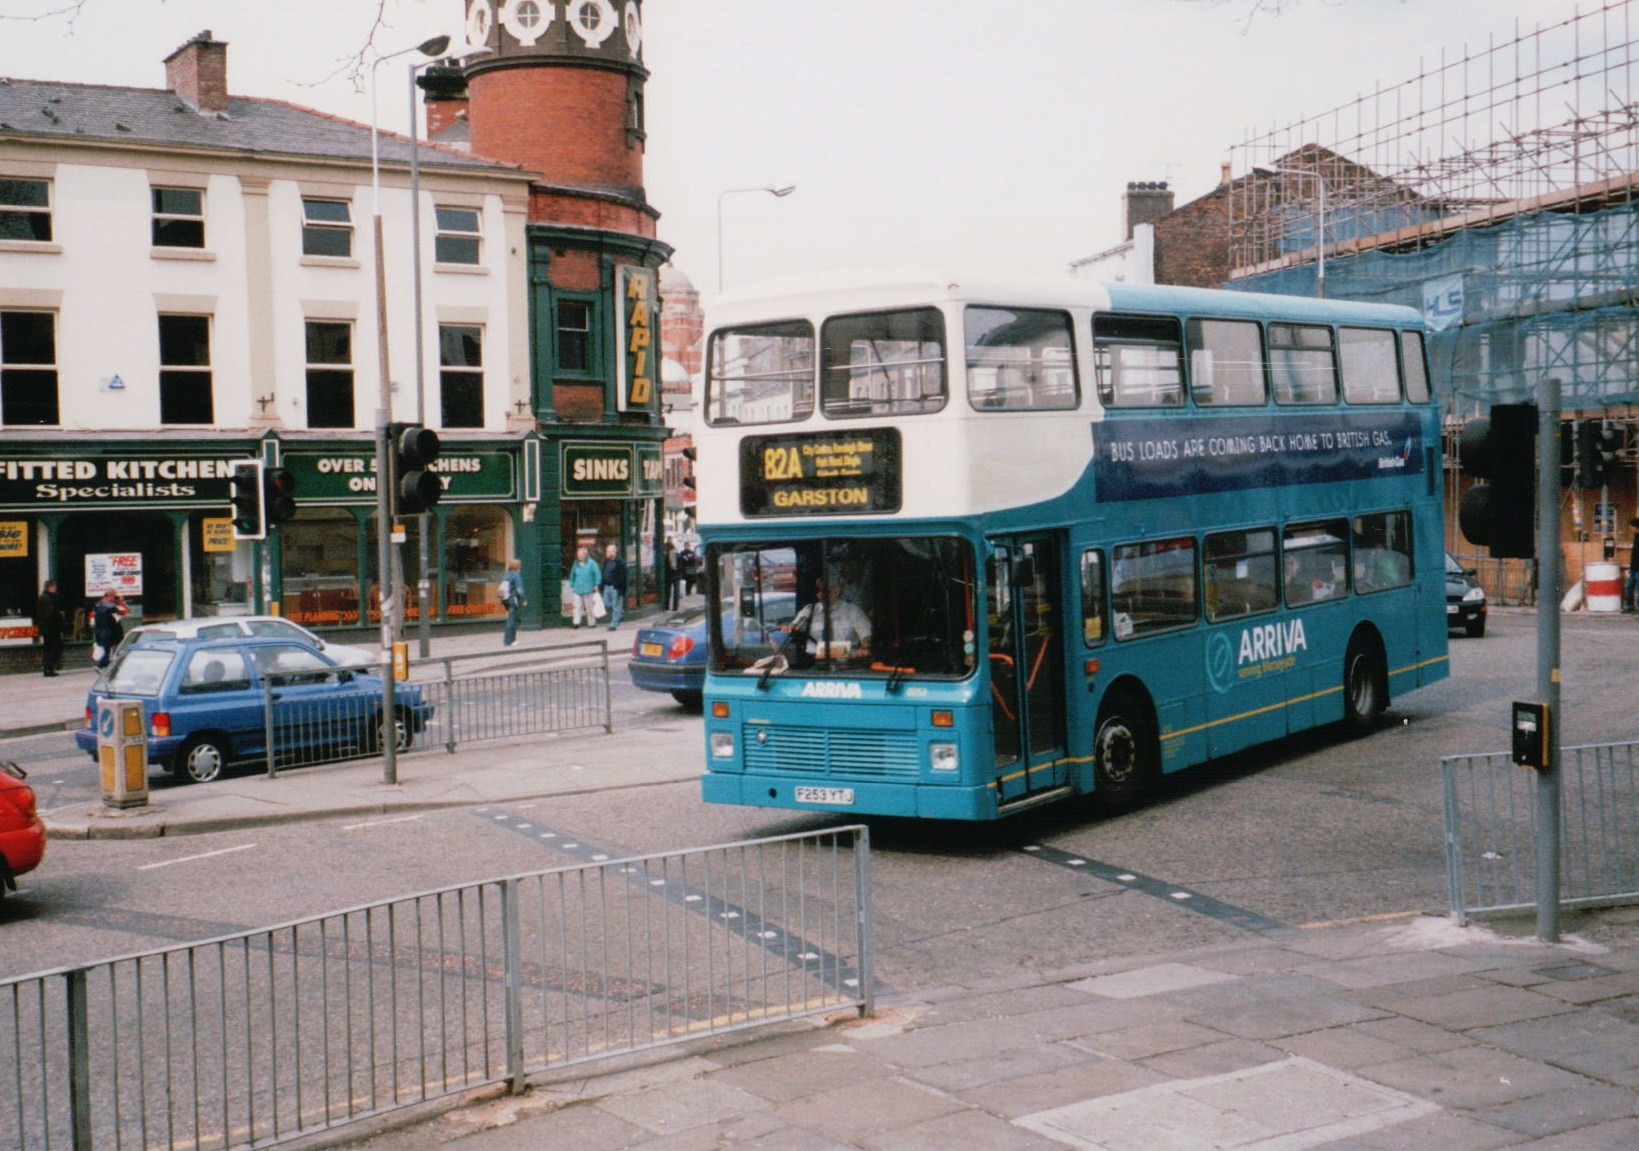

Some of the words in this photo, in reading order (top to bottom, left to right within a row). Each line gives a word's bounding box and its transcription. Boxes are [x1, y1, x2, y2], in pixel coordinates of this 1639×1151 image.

[627, 273, 651, 403] RAPID
[1110, 442, 1134, 462] BUS
[1138, 440, 1178, 461] LOADS
[1183, 438, 1204, 457] ARE
[1208, 436, 1256, 456] COMING
[1259, 435, 1286, 453] BACK
[1289, 433, 1318, 450] HOME
[1321, 432, 1334, 449] TO
[1336, 431, 1370, 448] BRITISH
[318, 458, 365, 473] OVER
[573, 458, 628, 480] SINKS
[764, 447, 803, 480] 82A
[36, 483, 196, 501] Specialists
[774, 487, 868, 507] GARSTON
[1238, 618, 1307, 665] ARRIVA
[801, 681, 862, 699] ARRIVA
[797, 787, 827, 801] F253
[831, 789, 853, 803] YTJ
